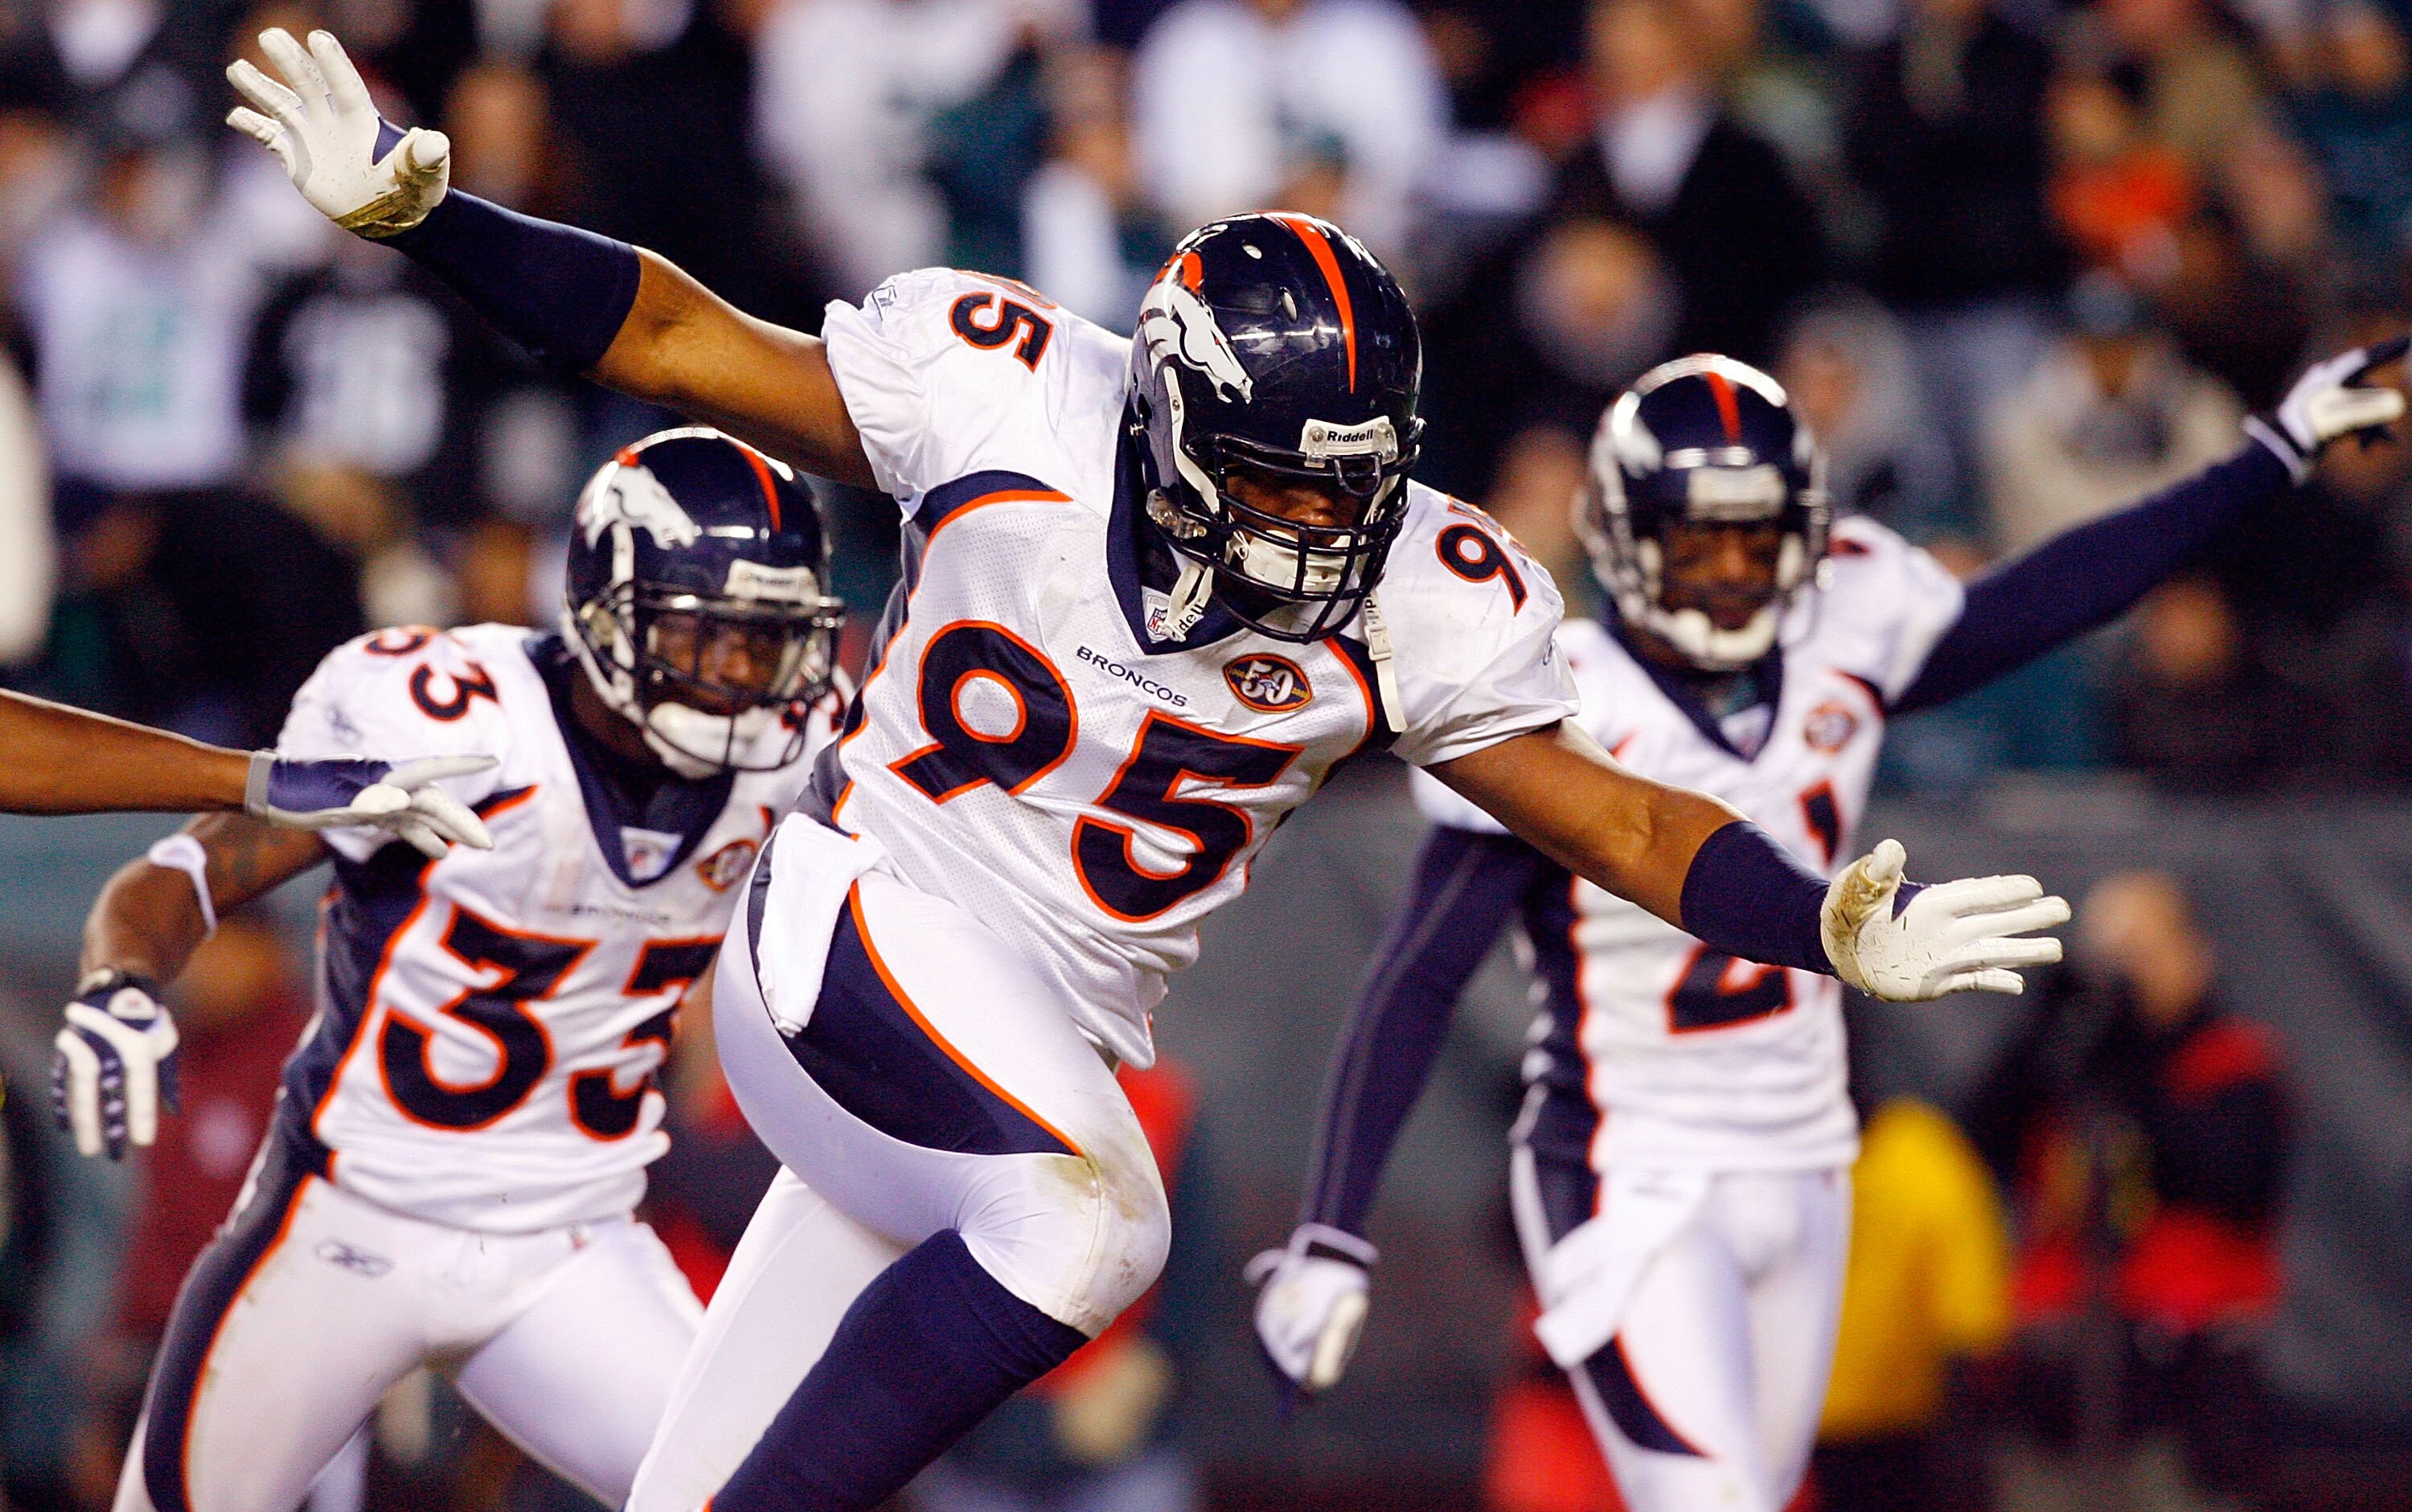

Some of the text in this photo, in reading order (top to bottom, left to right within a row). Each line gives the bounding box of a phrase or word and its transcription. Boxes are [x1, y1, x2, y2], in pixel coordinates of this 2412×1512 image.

[1327, 428, 1373, 443] Riddell
[1076, 645, 1188, 707] BRONCOS
[1241, 660, 1294, 704] 50
[888, 619, 1305, 923] 95
[378, 901, 725, 1142] 33
